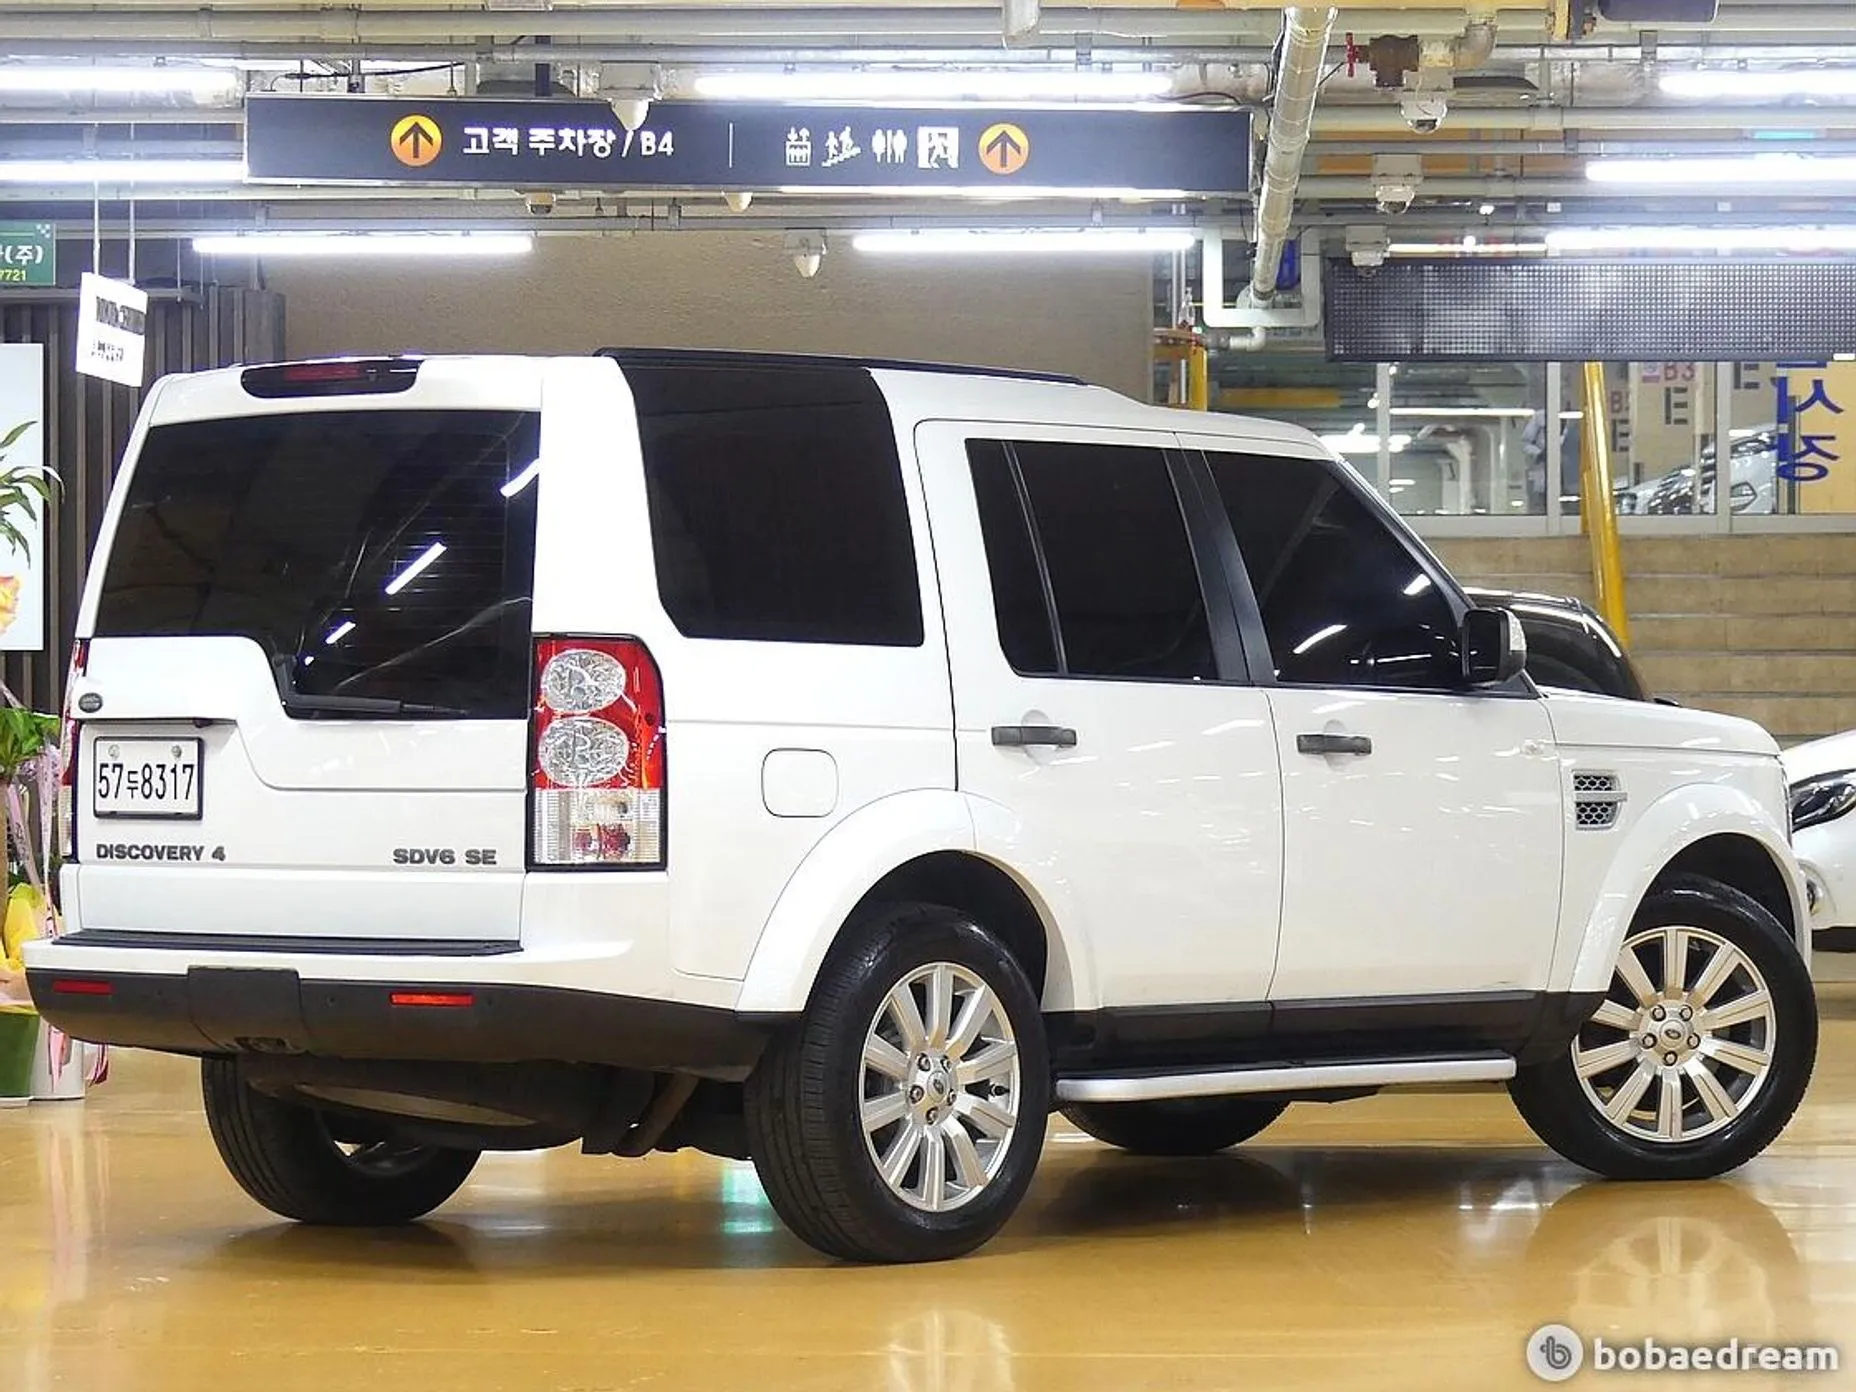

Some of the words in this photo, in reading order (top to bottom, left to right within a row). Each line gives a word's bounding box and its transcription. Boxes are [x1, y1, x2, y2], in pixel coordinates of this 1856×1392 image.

[463, 127, 518, 155] 고객
[528, 127, 616, 158] 주차장
[640, 130, 674, 156] B4
[0, 245, 43, 266] (주)
[98, 762, 195, 800] 57두8317
[96, 844, 204, 860] DISCOVERY
[211, 846, 226, 861] 4
[393, 848, 456, 865] SDV6
[465, 849, 497, 865] SE
